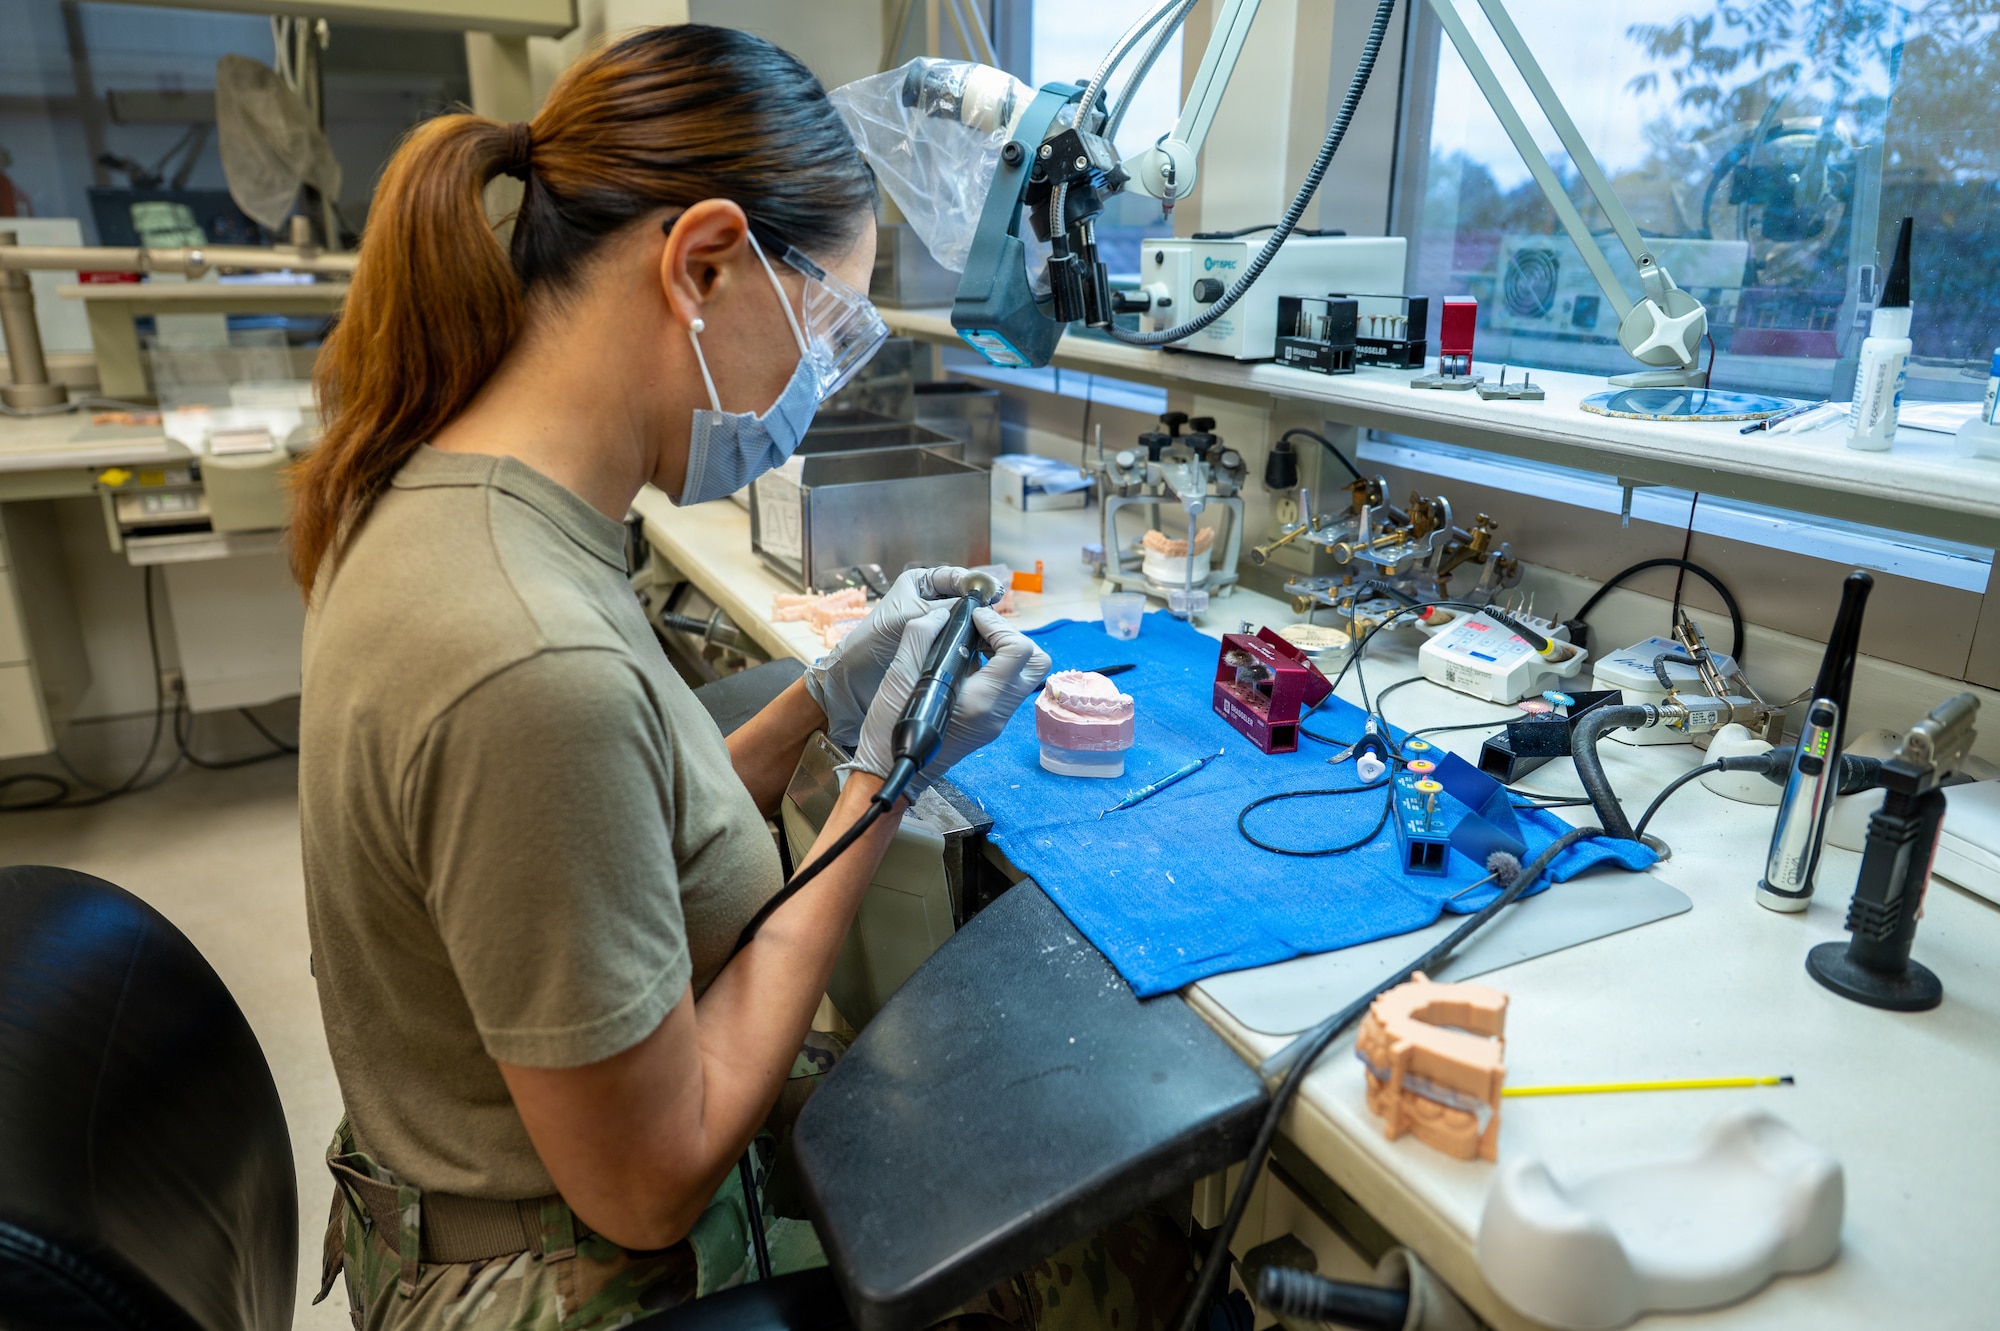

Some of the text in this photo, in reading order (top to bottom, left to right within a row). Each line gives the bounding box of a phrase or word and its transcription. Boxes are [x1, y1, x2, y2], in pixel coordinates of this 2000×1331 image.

[1293, 347, 1317, 359] BRASSELER
[1356, 345, 1388, 356] RASSELER
[1230, 703, 1254, 727] BRASSELER
[1787, 857, 1801, 885] VALO
